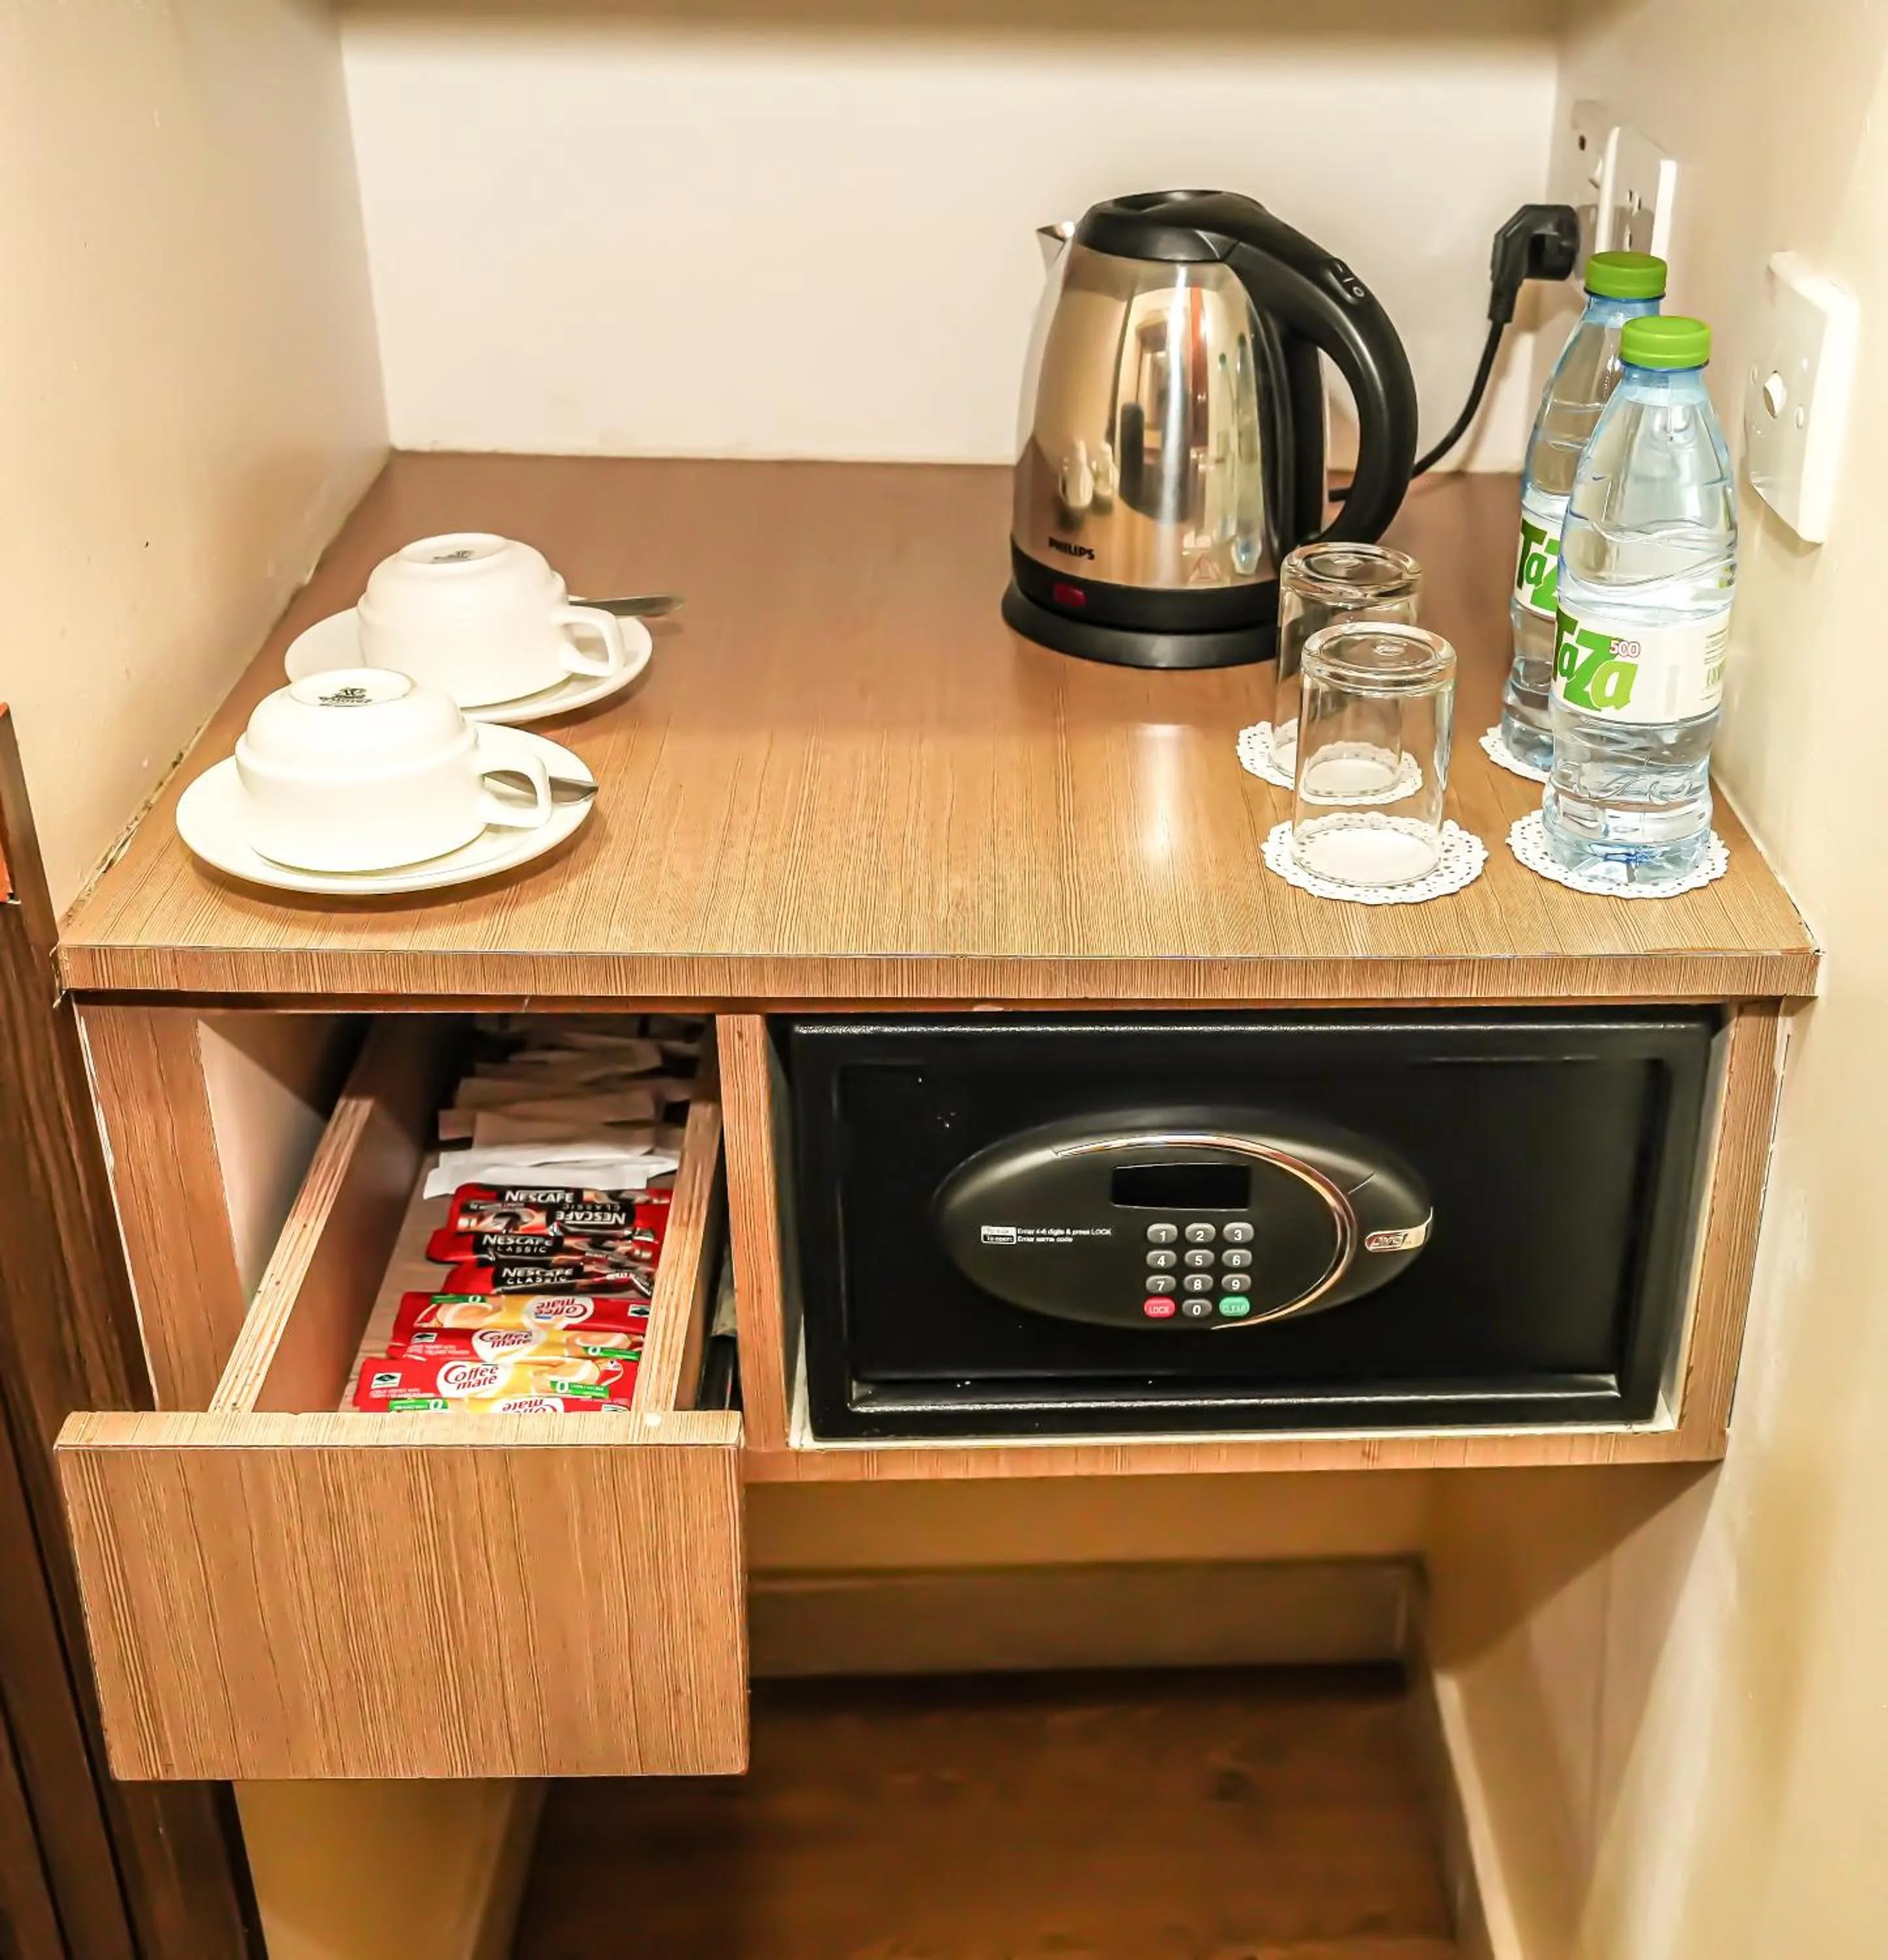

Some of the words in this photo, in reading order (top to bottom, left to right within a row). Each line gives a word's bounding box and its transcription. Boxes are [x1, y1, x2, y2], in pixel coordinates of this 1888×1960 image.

[1048, 536, 1096, 561] PHILIPS
[1608, 639, 1641, 659] 500
[1160, 1230, 1166, 1241] 1
[1196, 1230, 1204, 1241] 2
[1234, 1230, 1242, 1241] 3
[1157, 1255, 1165, 1267] 4
[1194, 1255, 1203, 1266] 5
[1233, 1254, 1241, 1266] 6
[1156, 1281, 1165, 1291] 7
[1194, 1279, 1202, 1290] 8
[1231, 1279, 1241, 1290] 9
[536, 1298, 576, 1309] mate
[1192, 1305, 1201, 1315] 0
[444, 1364, 499, 1384] Coffee
[456, 1375, 498, 1391] mate
[502, 1399, 544, 1412] mate
